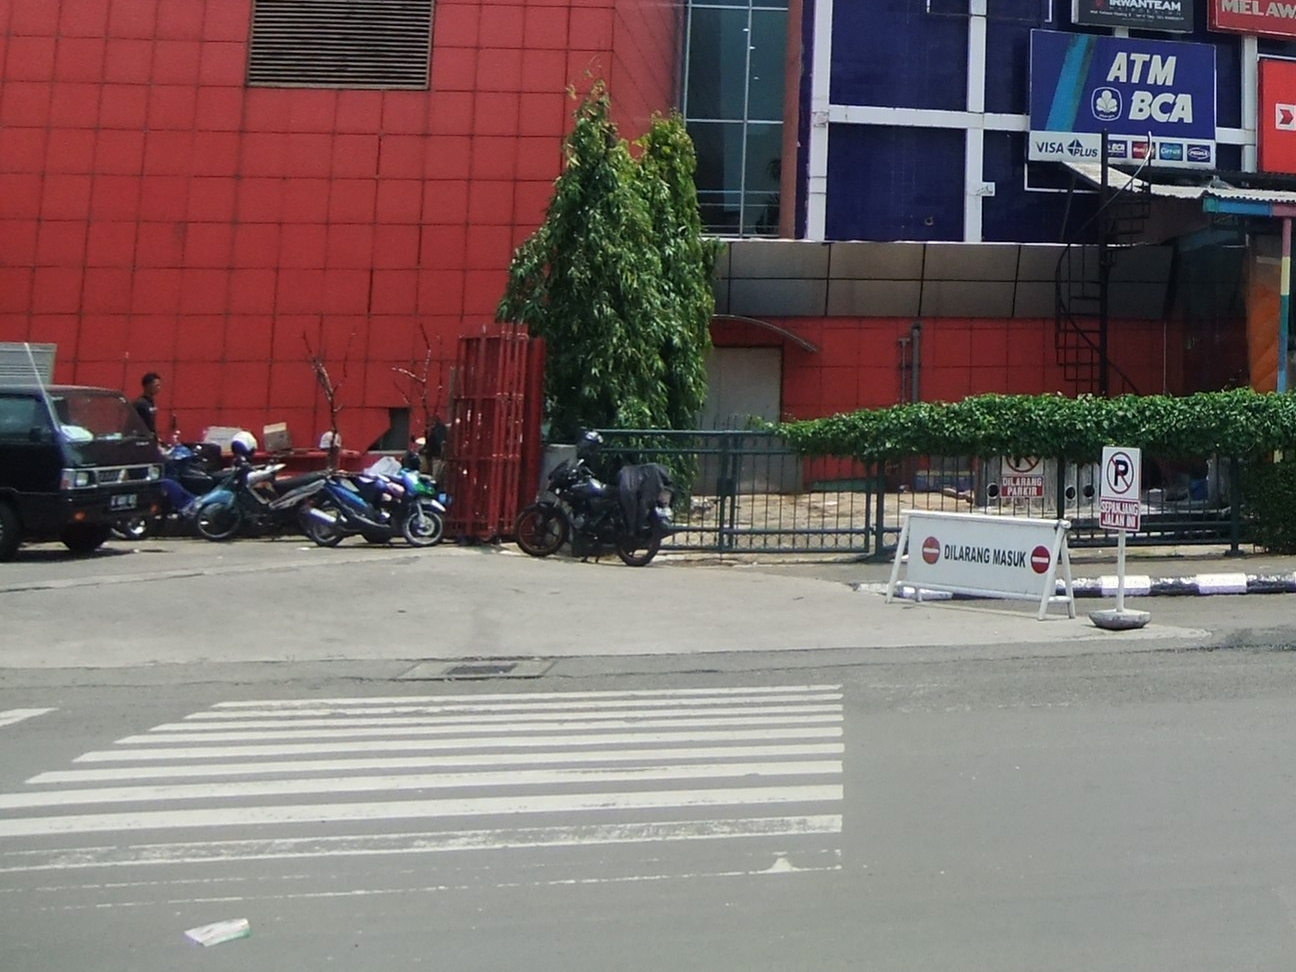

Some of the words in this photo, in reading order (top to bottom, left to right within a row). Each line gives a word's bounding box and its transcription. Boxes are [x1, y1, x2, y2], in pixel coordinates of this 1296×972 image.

[1106, 52, 1177, 86] ATM
[1128, 91, 1194, 124] BCA
[1036, 141, 1064, 154] VISA
[1073, 147, 1099, 158] PLUS
[1002, 477, 1042, 486] DILARANG
[1007, 486, 1038, 496] PARKIR
[1101, 501, 1139, 515] SEPANJANG
[1102, 513, 1123, 526] JALAN
[1126, 515, 1137, 527] INI
[943, 543, 990, 564] DILARANG
[993, 548, 1027, 568] MASUK
